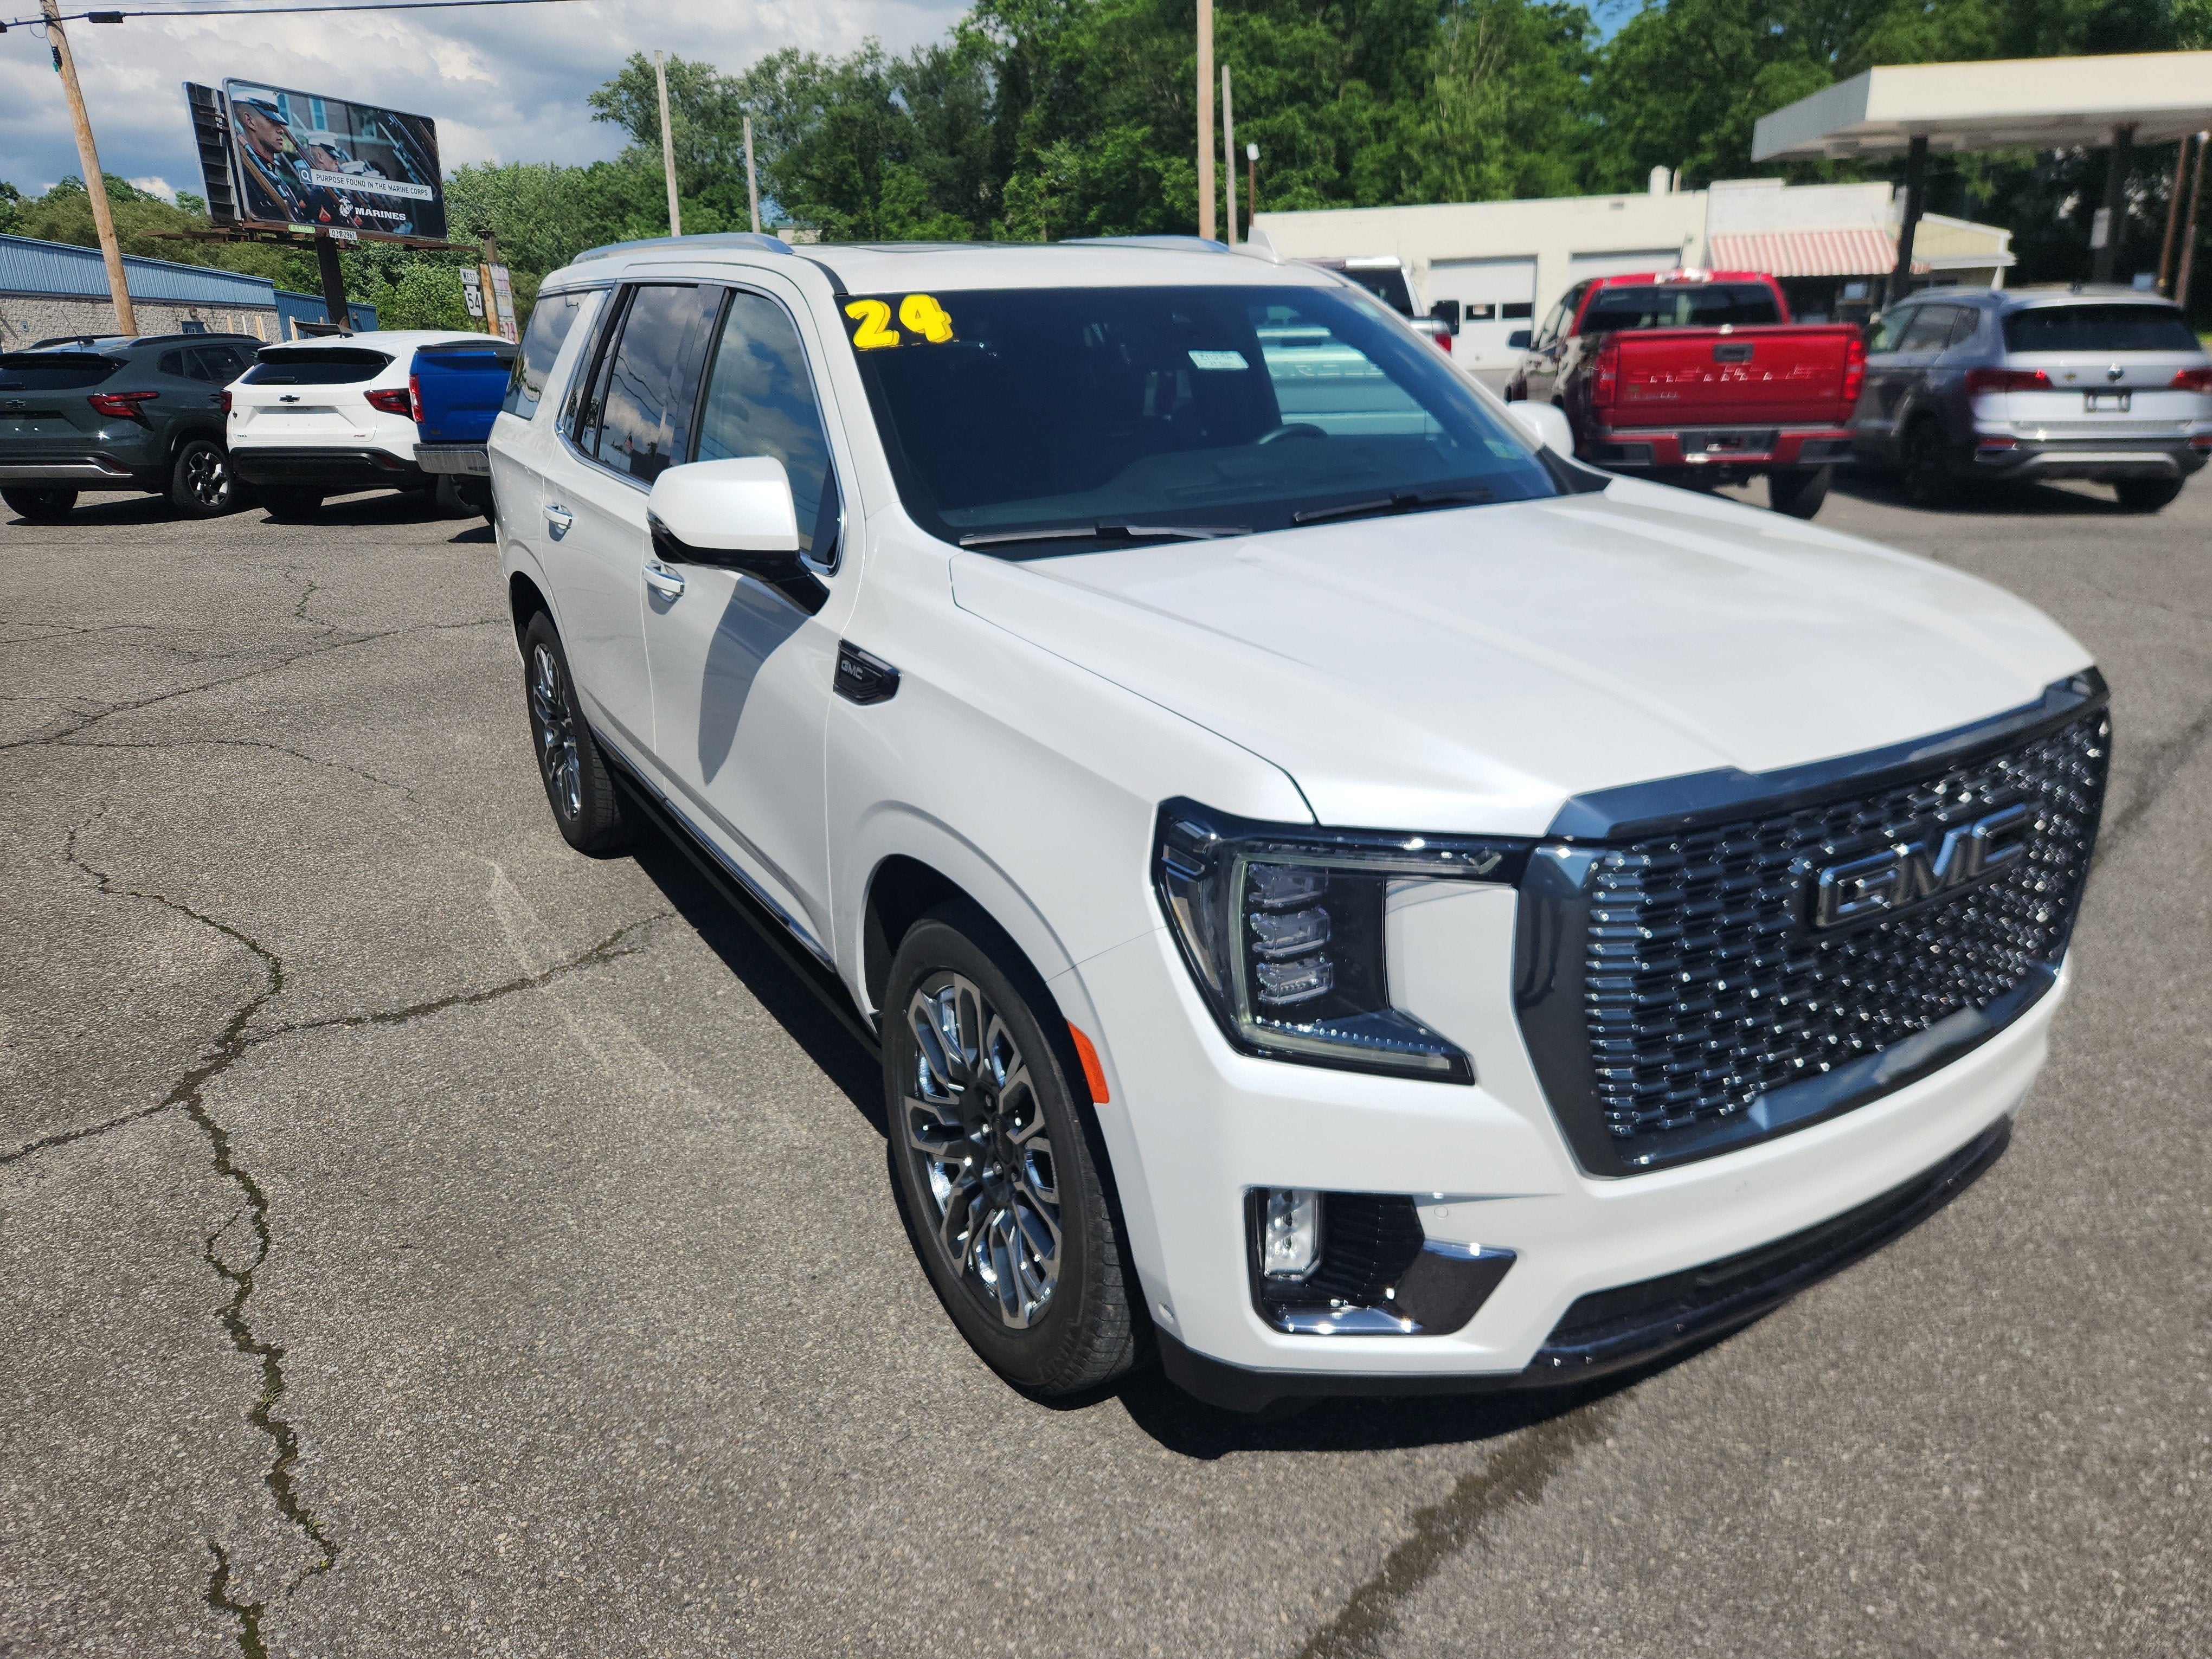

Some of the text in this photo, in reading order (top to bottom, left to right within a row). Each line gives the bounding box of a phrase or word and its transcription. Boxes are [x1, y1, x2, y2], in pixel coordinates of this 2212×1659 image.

[316, 173, 428, 196] PURPOSE FOUND IN THE MARINE CORPS
[354, 207, 407, 221] MARINES
[291, 224, 313, 233] LAMAR
[462, 271, 476, 282] WEST
[467, 292, 481, 310] 54
[844, 293, 954, 349] 24
[841, 660, 863, 680] GMC
[1815, 802, 2028, 928] GMC
